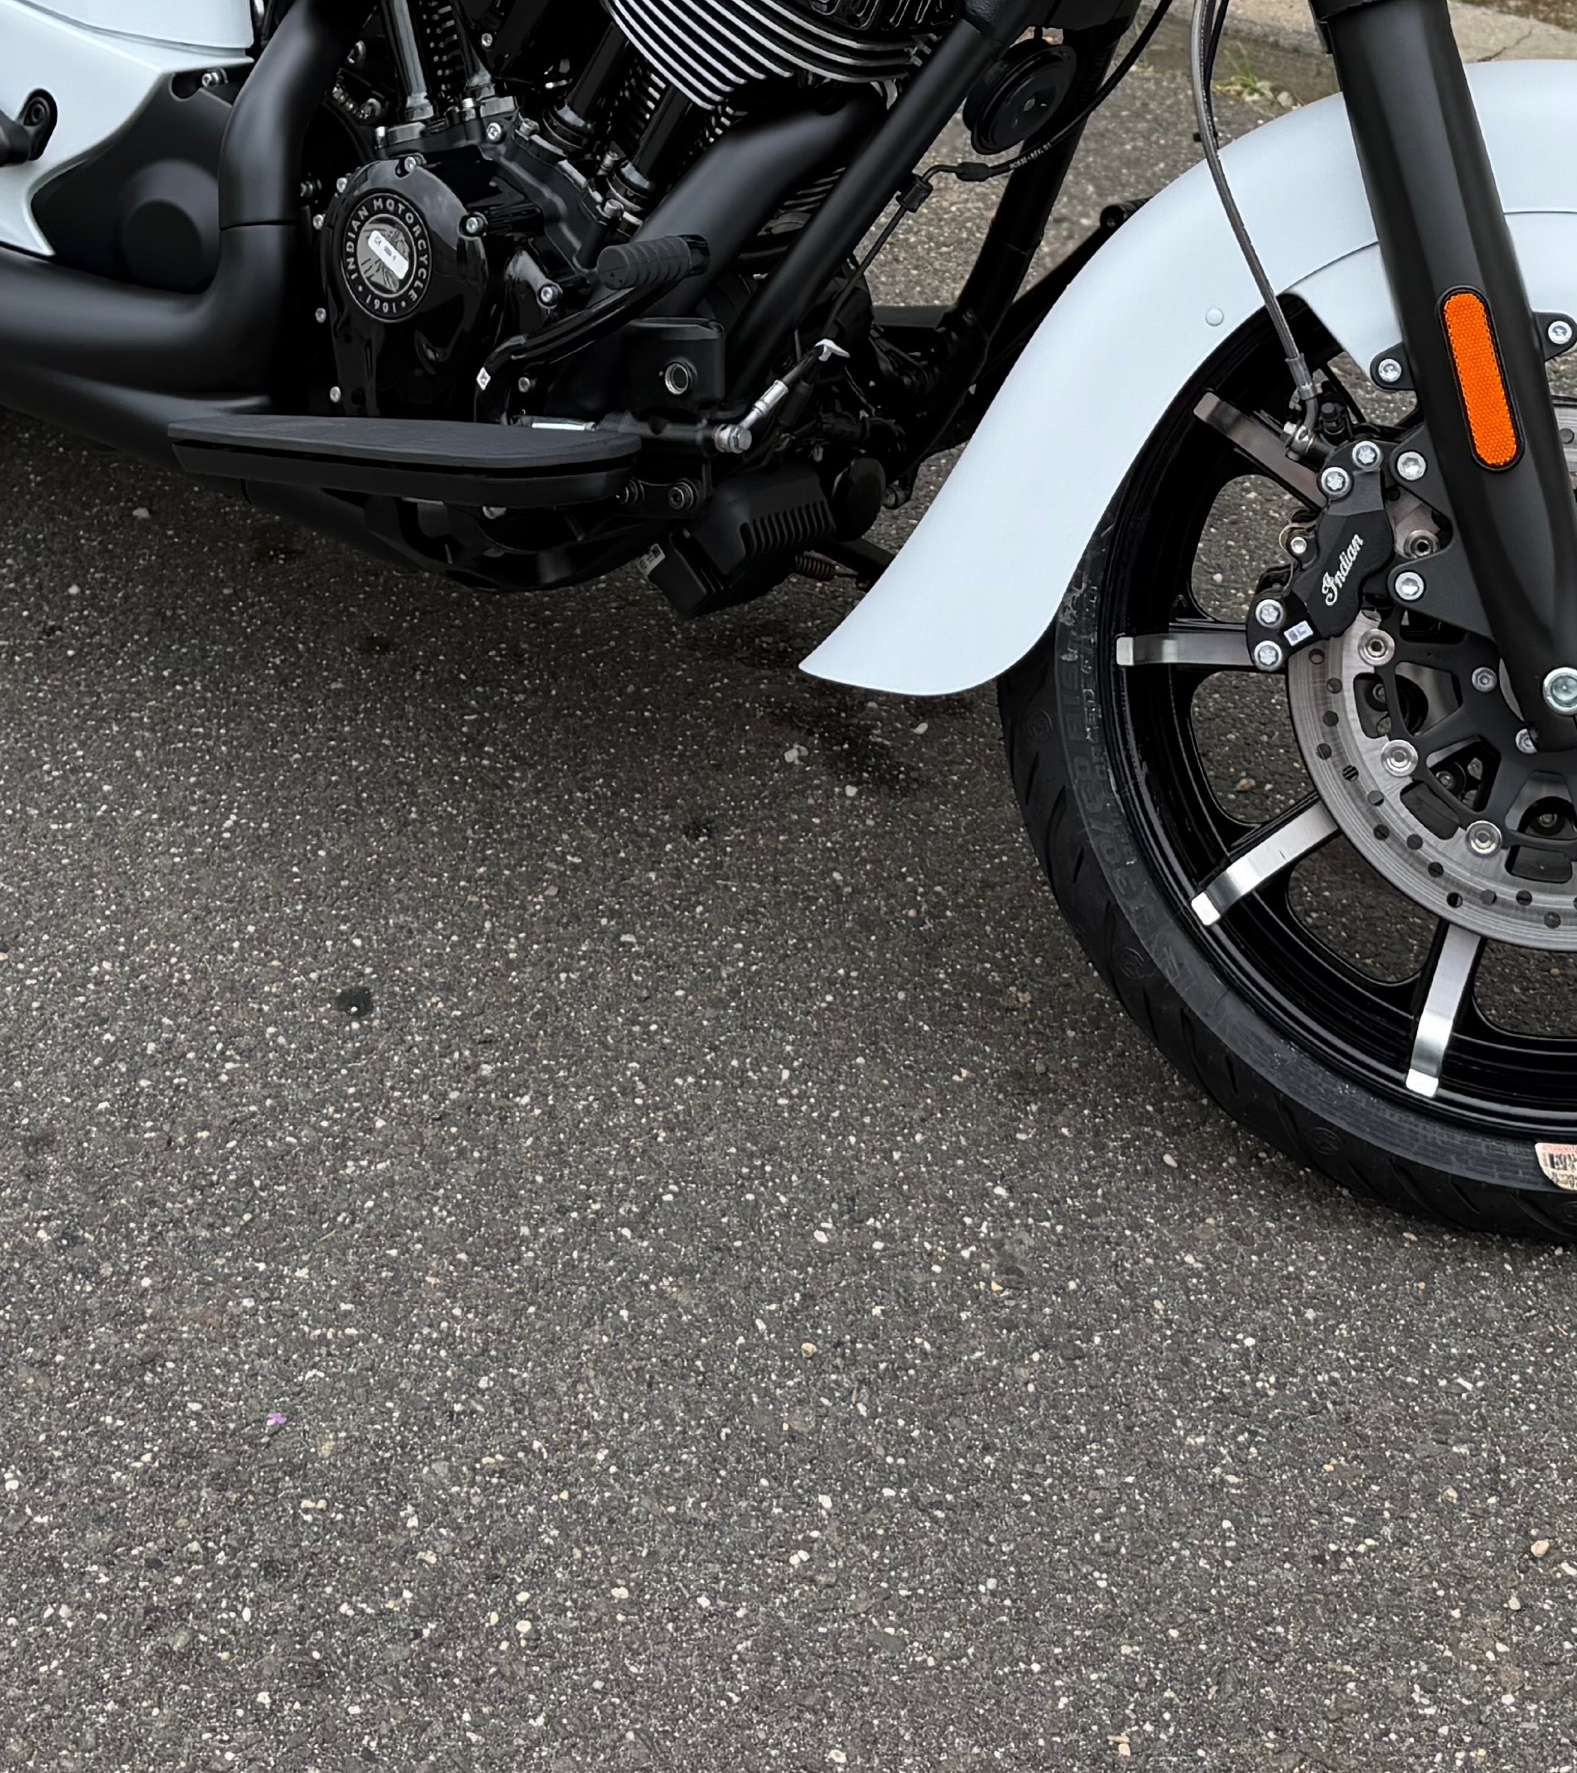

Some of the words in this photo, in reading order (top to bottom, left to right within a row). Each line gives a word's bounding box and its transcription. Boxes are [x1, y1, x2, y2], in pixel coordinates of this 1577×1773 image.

[345, 205, 370, 281] INDIAN
[372, 197, 430, 302] MOTORCYCLE
[1319, 533, 1364, 608] Indian
